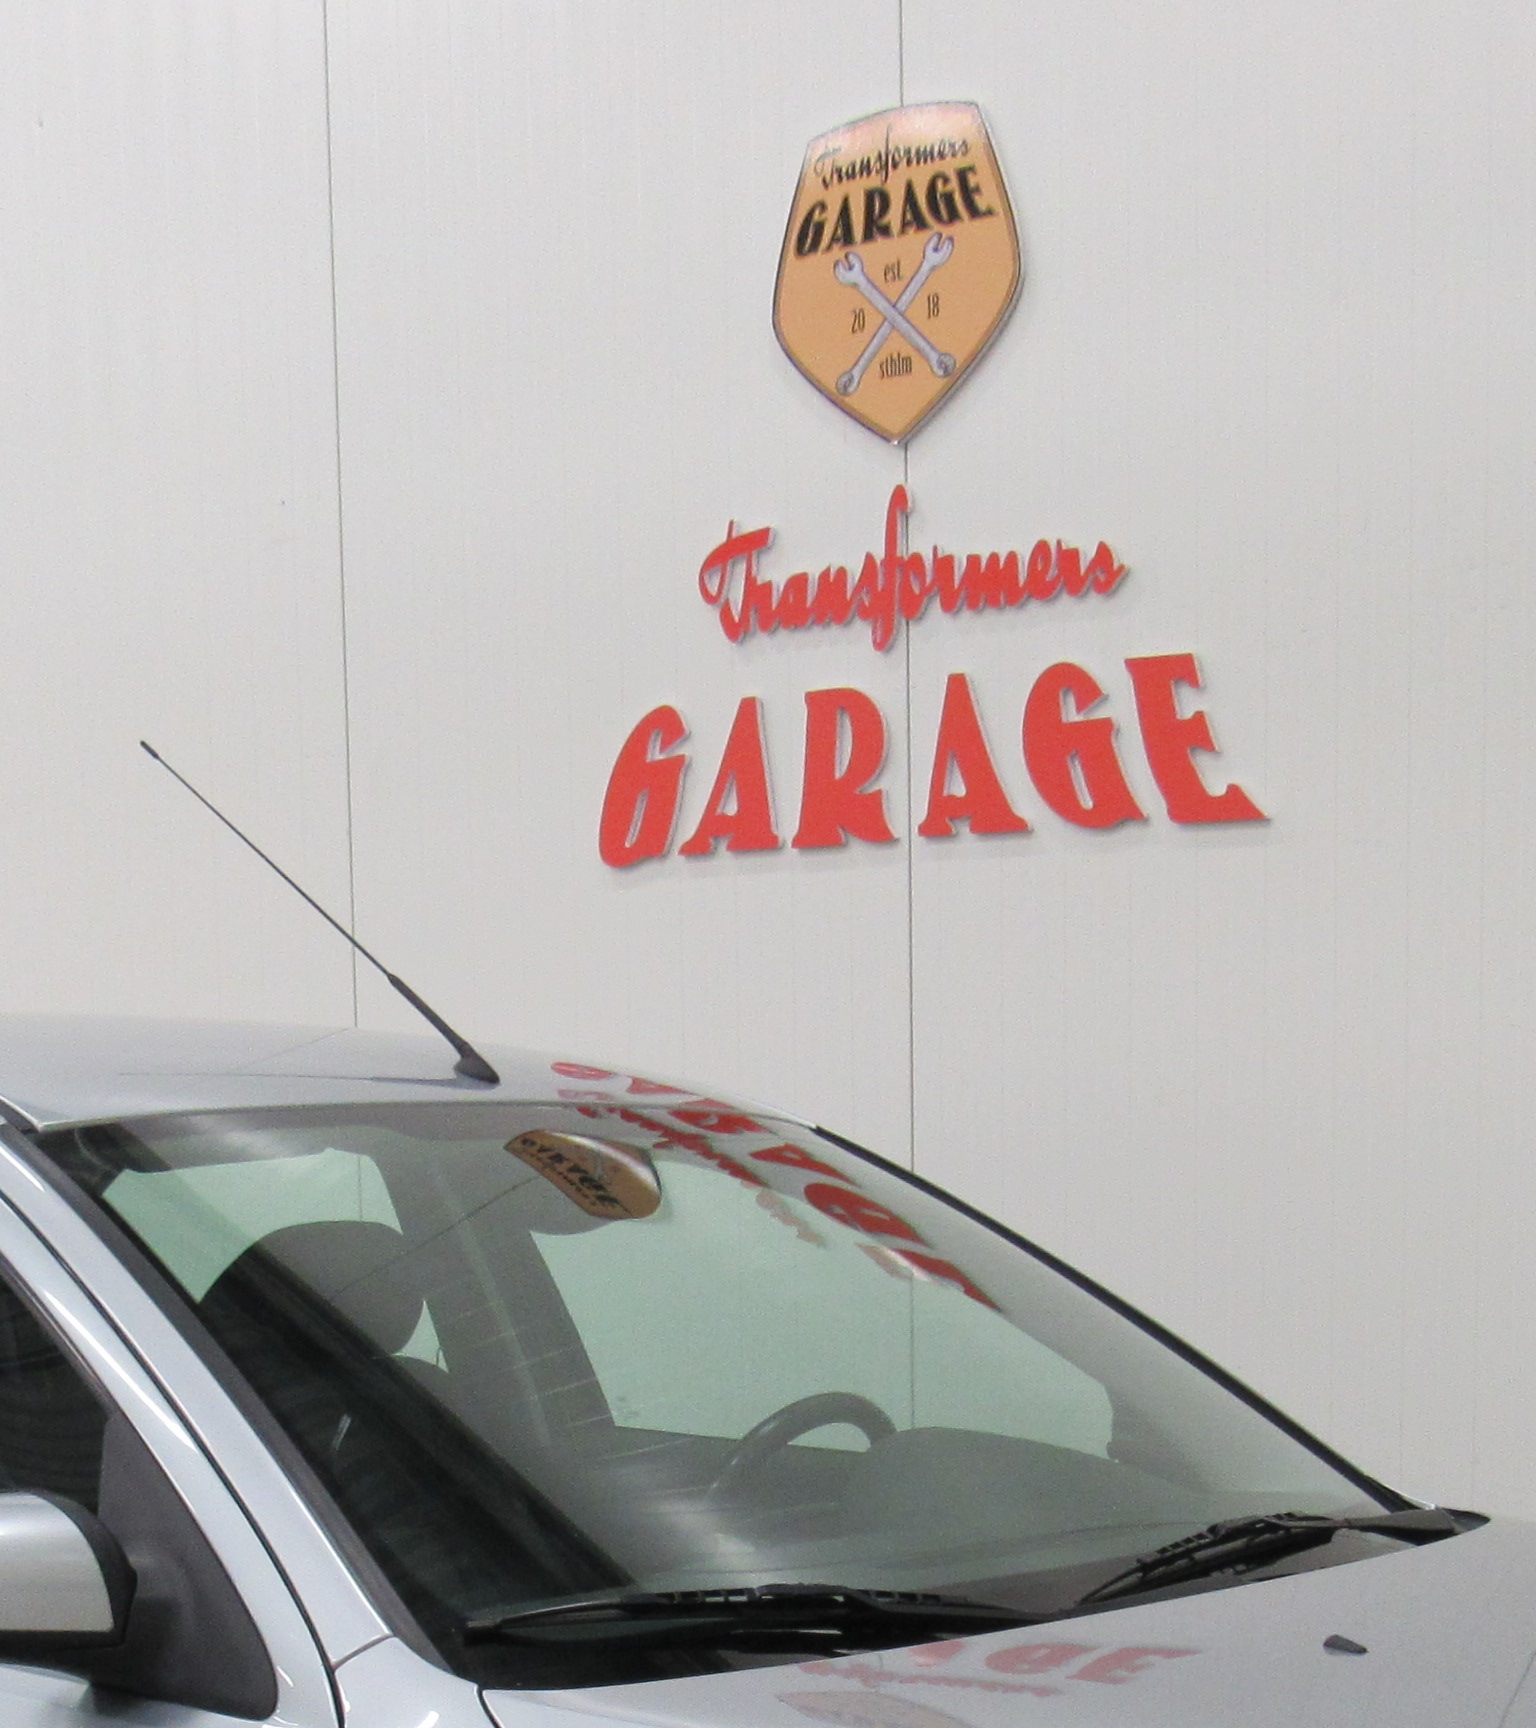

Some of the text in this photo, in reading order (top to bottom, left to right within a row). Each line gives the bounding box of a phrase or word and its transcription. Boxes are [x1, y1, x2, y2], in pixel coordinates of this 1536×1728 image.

[813, 124, 971, 190] Transformers
[794, 164, 997, 259] GARAGE
[883, 260, 902, 282] est
[851, 294, 940, 334] 20 18
[879, 351, 913, 379] sthlm
[699, 483, 1126, 652] Transformers
[598, 652, 1270, 870] GARAGE
